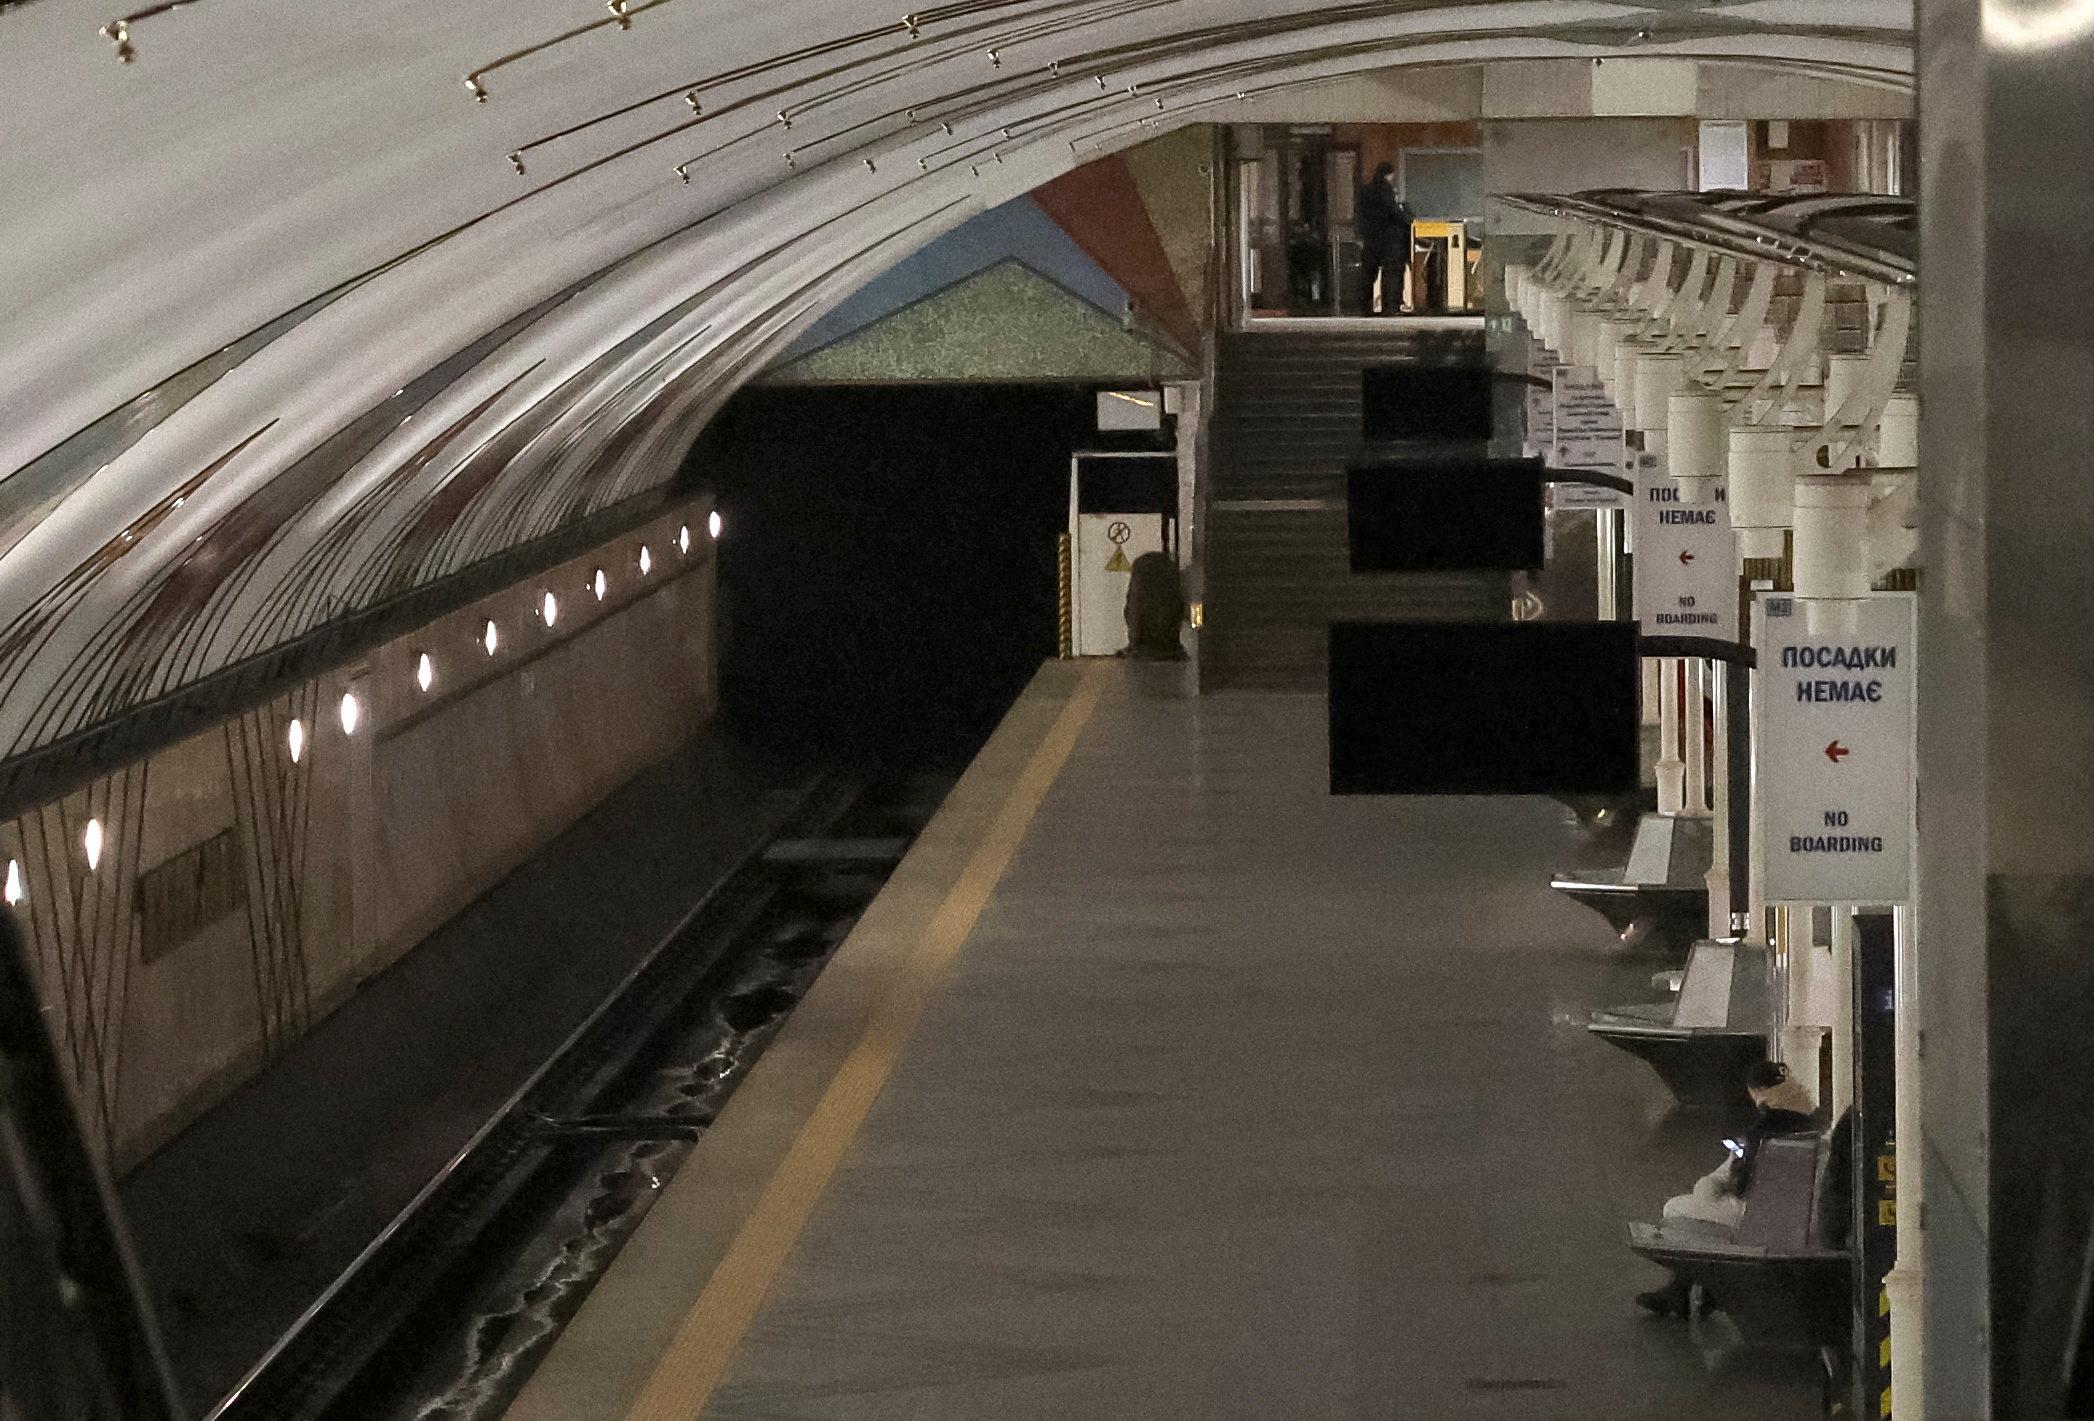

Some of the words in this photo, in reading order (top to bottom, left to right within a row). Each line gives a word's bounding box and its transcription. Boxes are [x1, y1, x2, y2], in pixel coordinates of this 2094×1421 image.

[1649, 487, 1726, 502] ПОСИ
[1659, 509, 1716, 525] НЕМАЄ
[1679, 596, 1695, 608] NO
[1656, 613, 1718, 624] BOARDING
[1782, 646, 1896, 671] ПОСАДКИ
[1797, 680, 1882, 702] НЕМАЄ
[1824, 810, 1849, 827] NO
[1790, 836, 1882, 852] BOARDING
